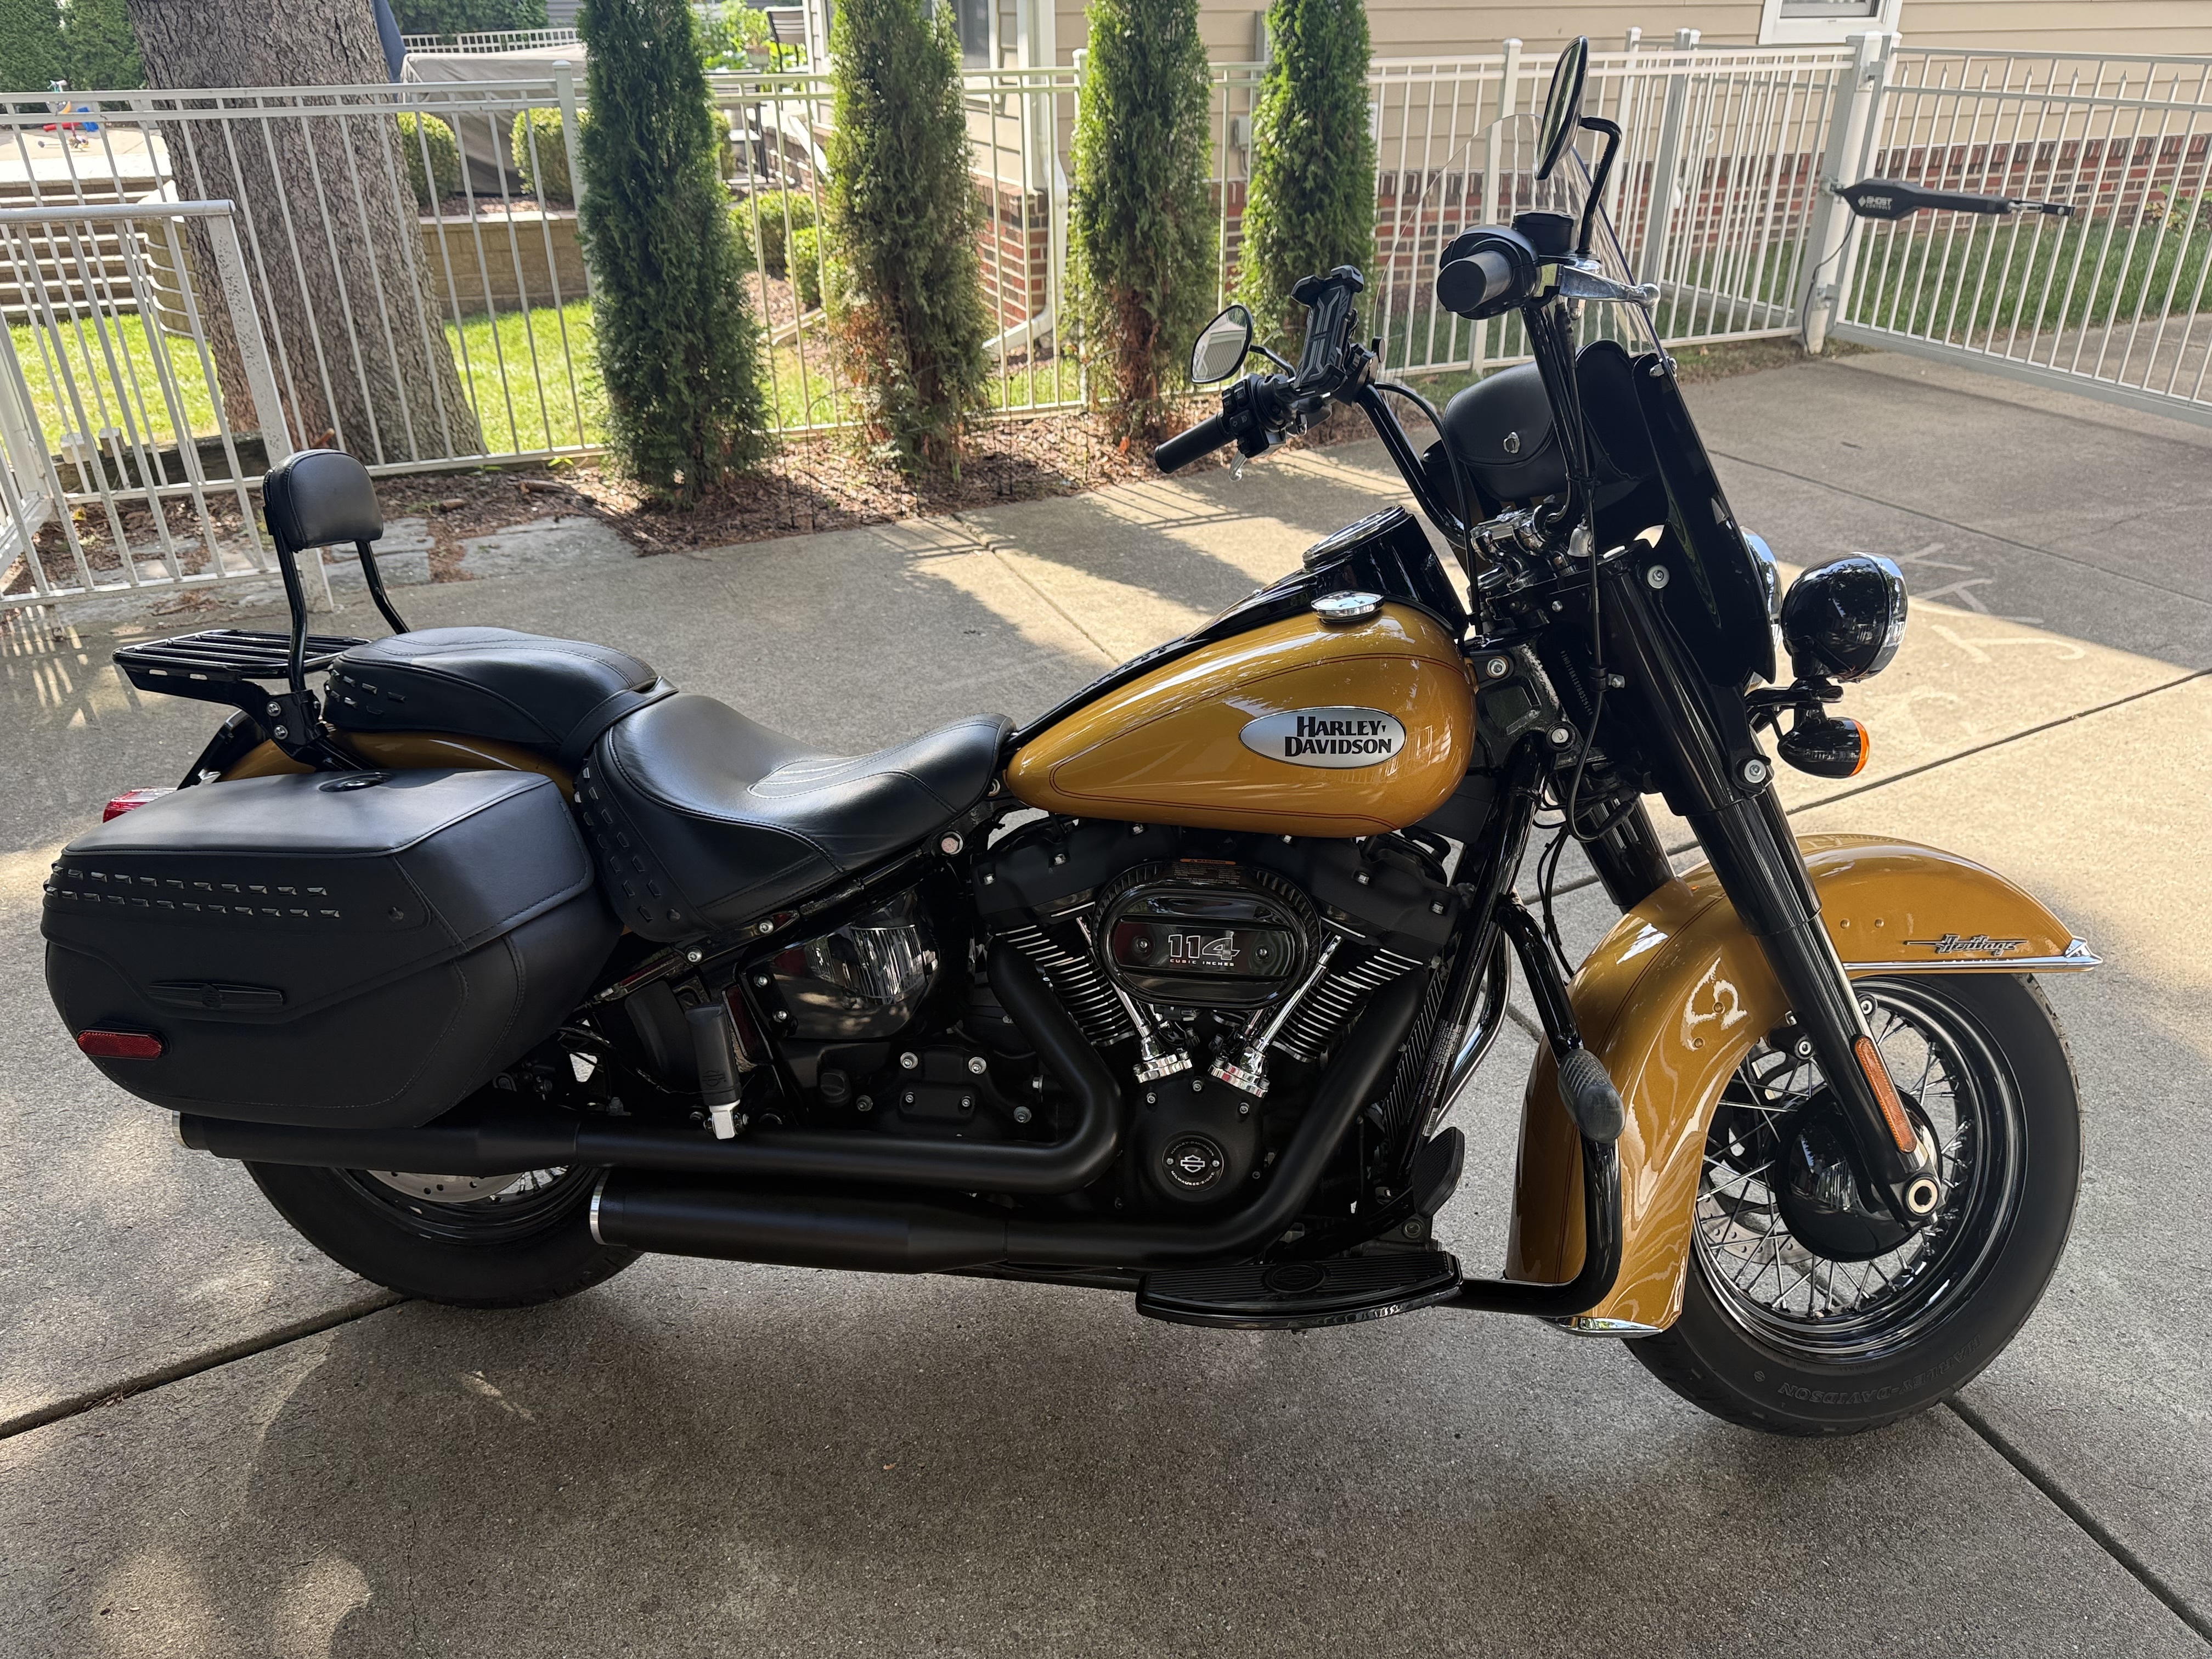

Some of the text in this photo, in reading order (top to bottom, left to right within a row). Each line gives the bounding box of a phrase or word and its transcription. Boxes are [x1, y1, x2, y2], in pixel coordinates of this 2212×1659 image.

[1866, 196, 1892, 205] GHOST
[1284, 736, 1392, 757] DAVIDSON
[1168, 931, 1241, 961] 114
[1934, 934, 2019, 956] Heritage
[1777, 1334, 1983, 1406] HARLEY-DAVIDSON
